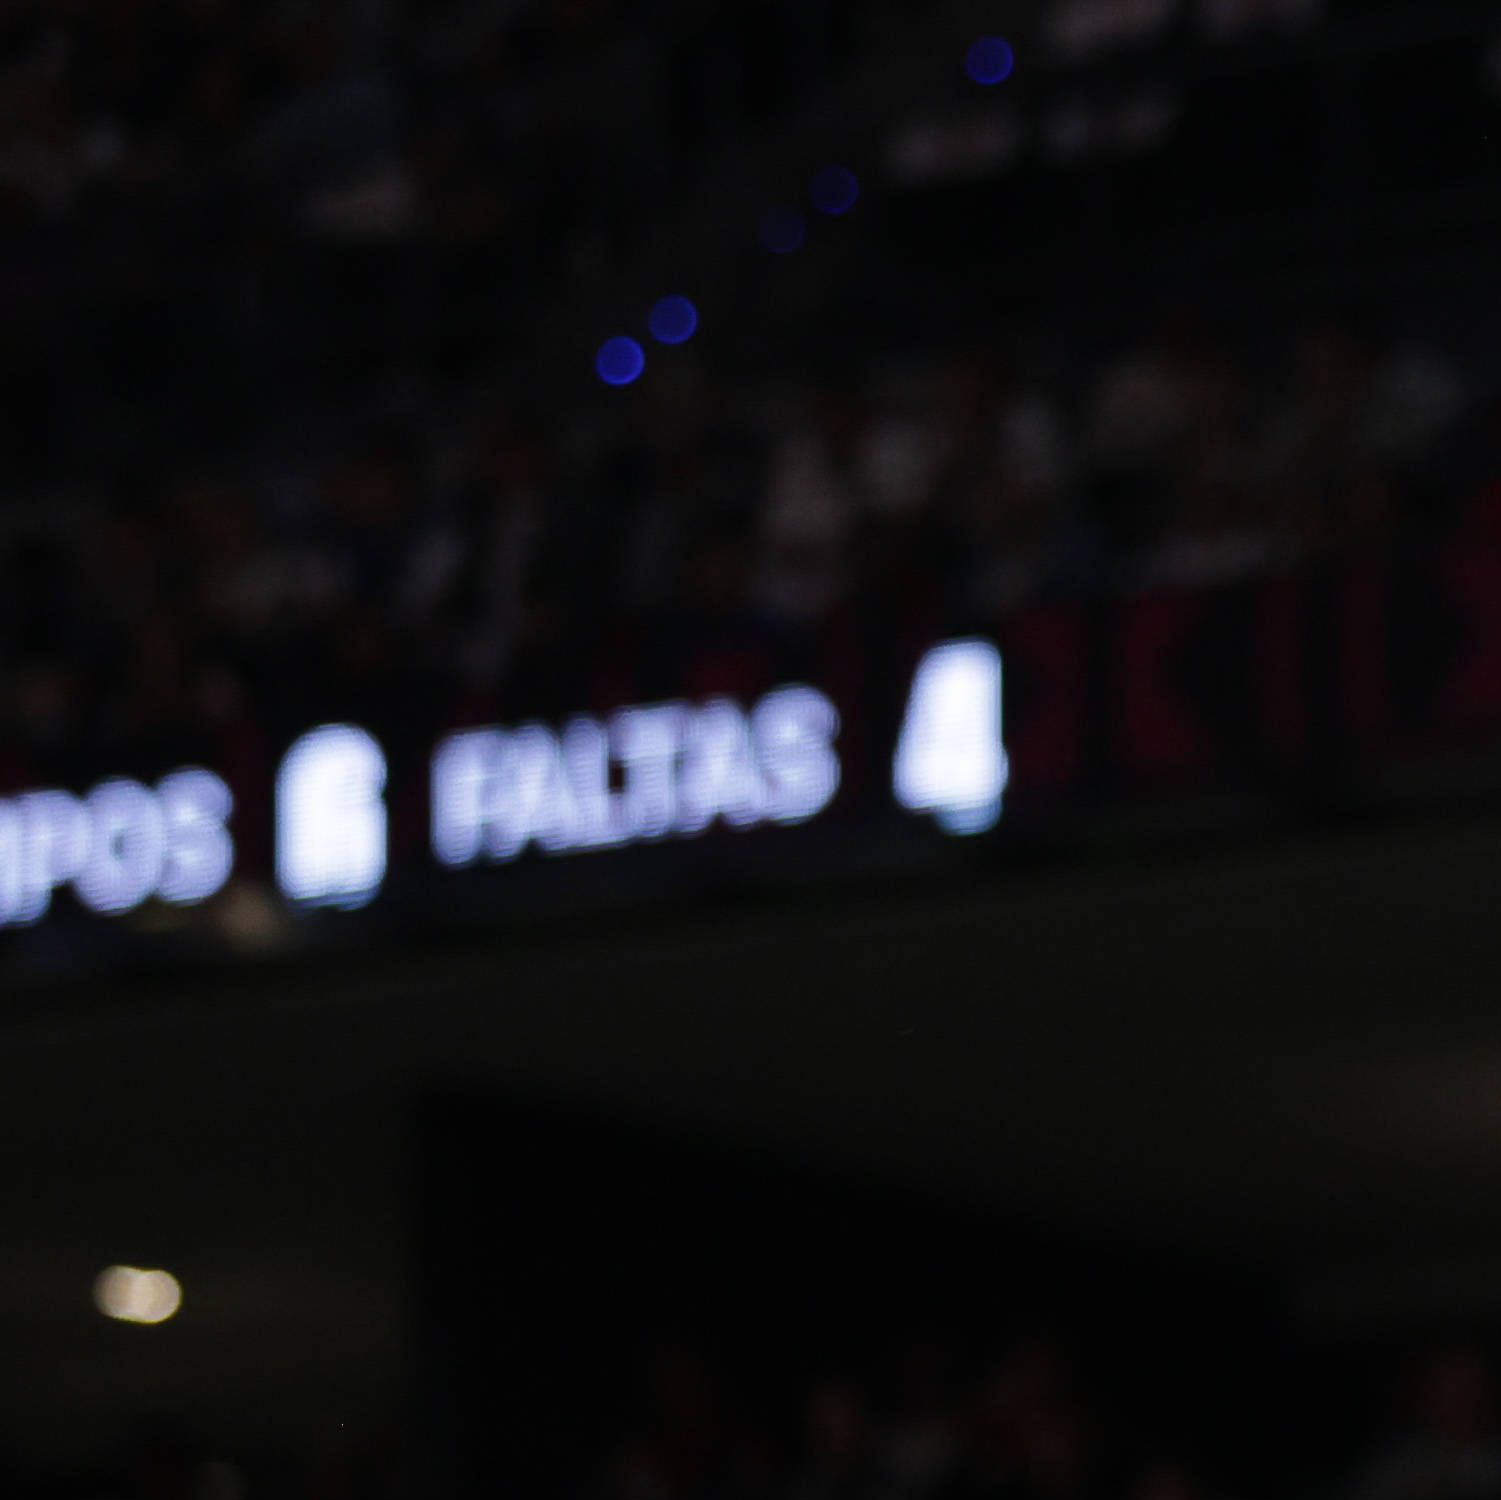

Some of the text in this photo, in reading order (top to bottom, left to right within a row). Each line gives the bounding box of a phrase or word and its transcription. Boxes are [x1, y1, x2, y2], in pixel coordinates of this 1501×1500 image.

[0, 639, 1011, 926] POS 6 FALTAS 4
